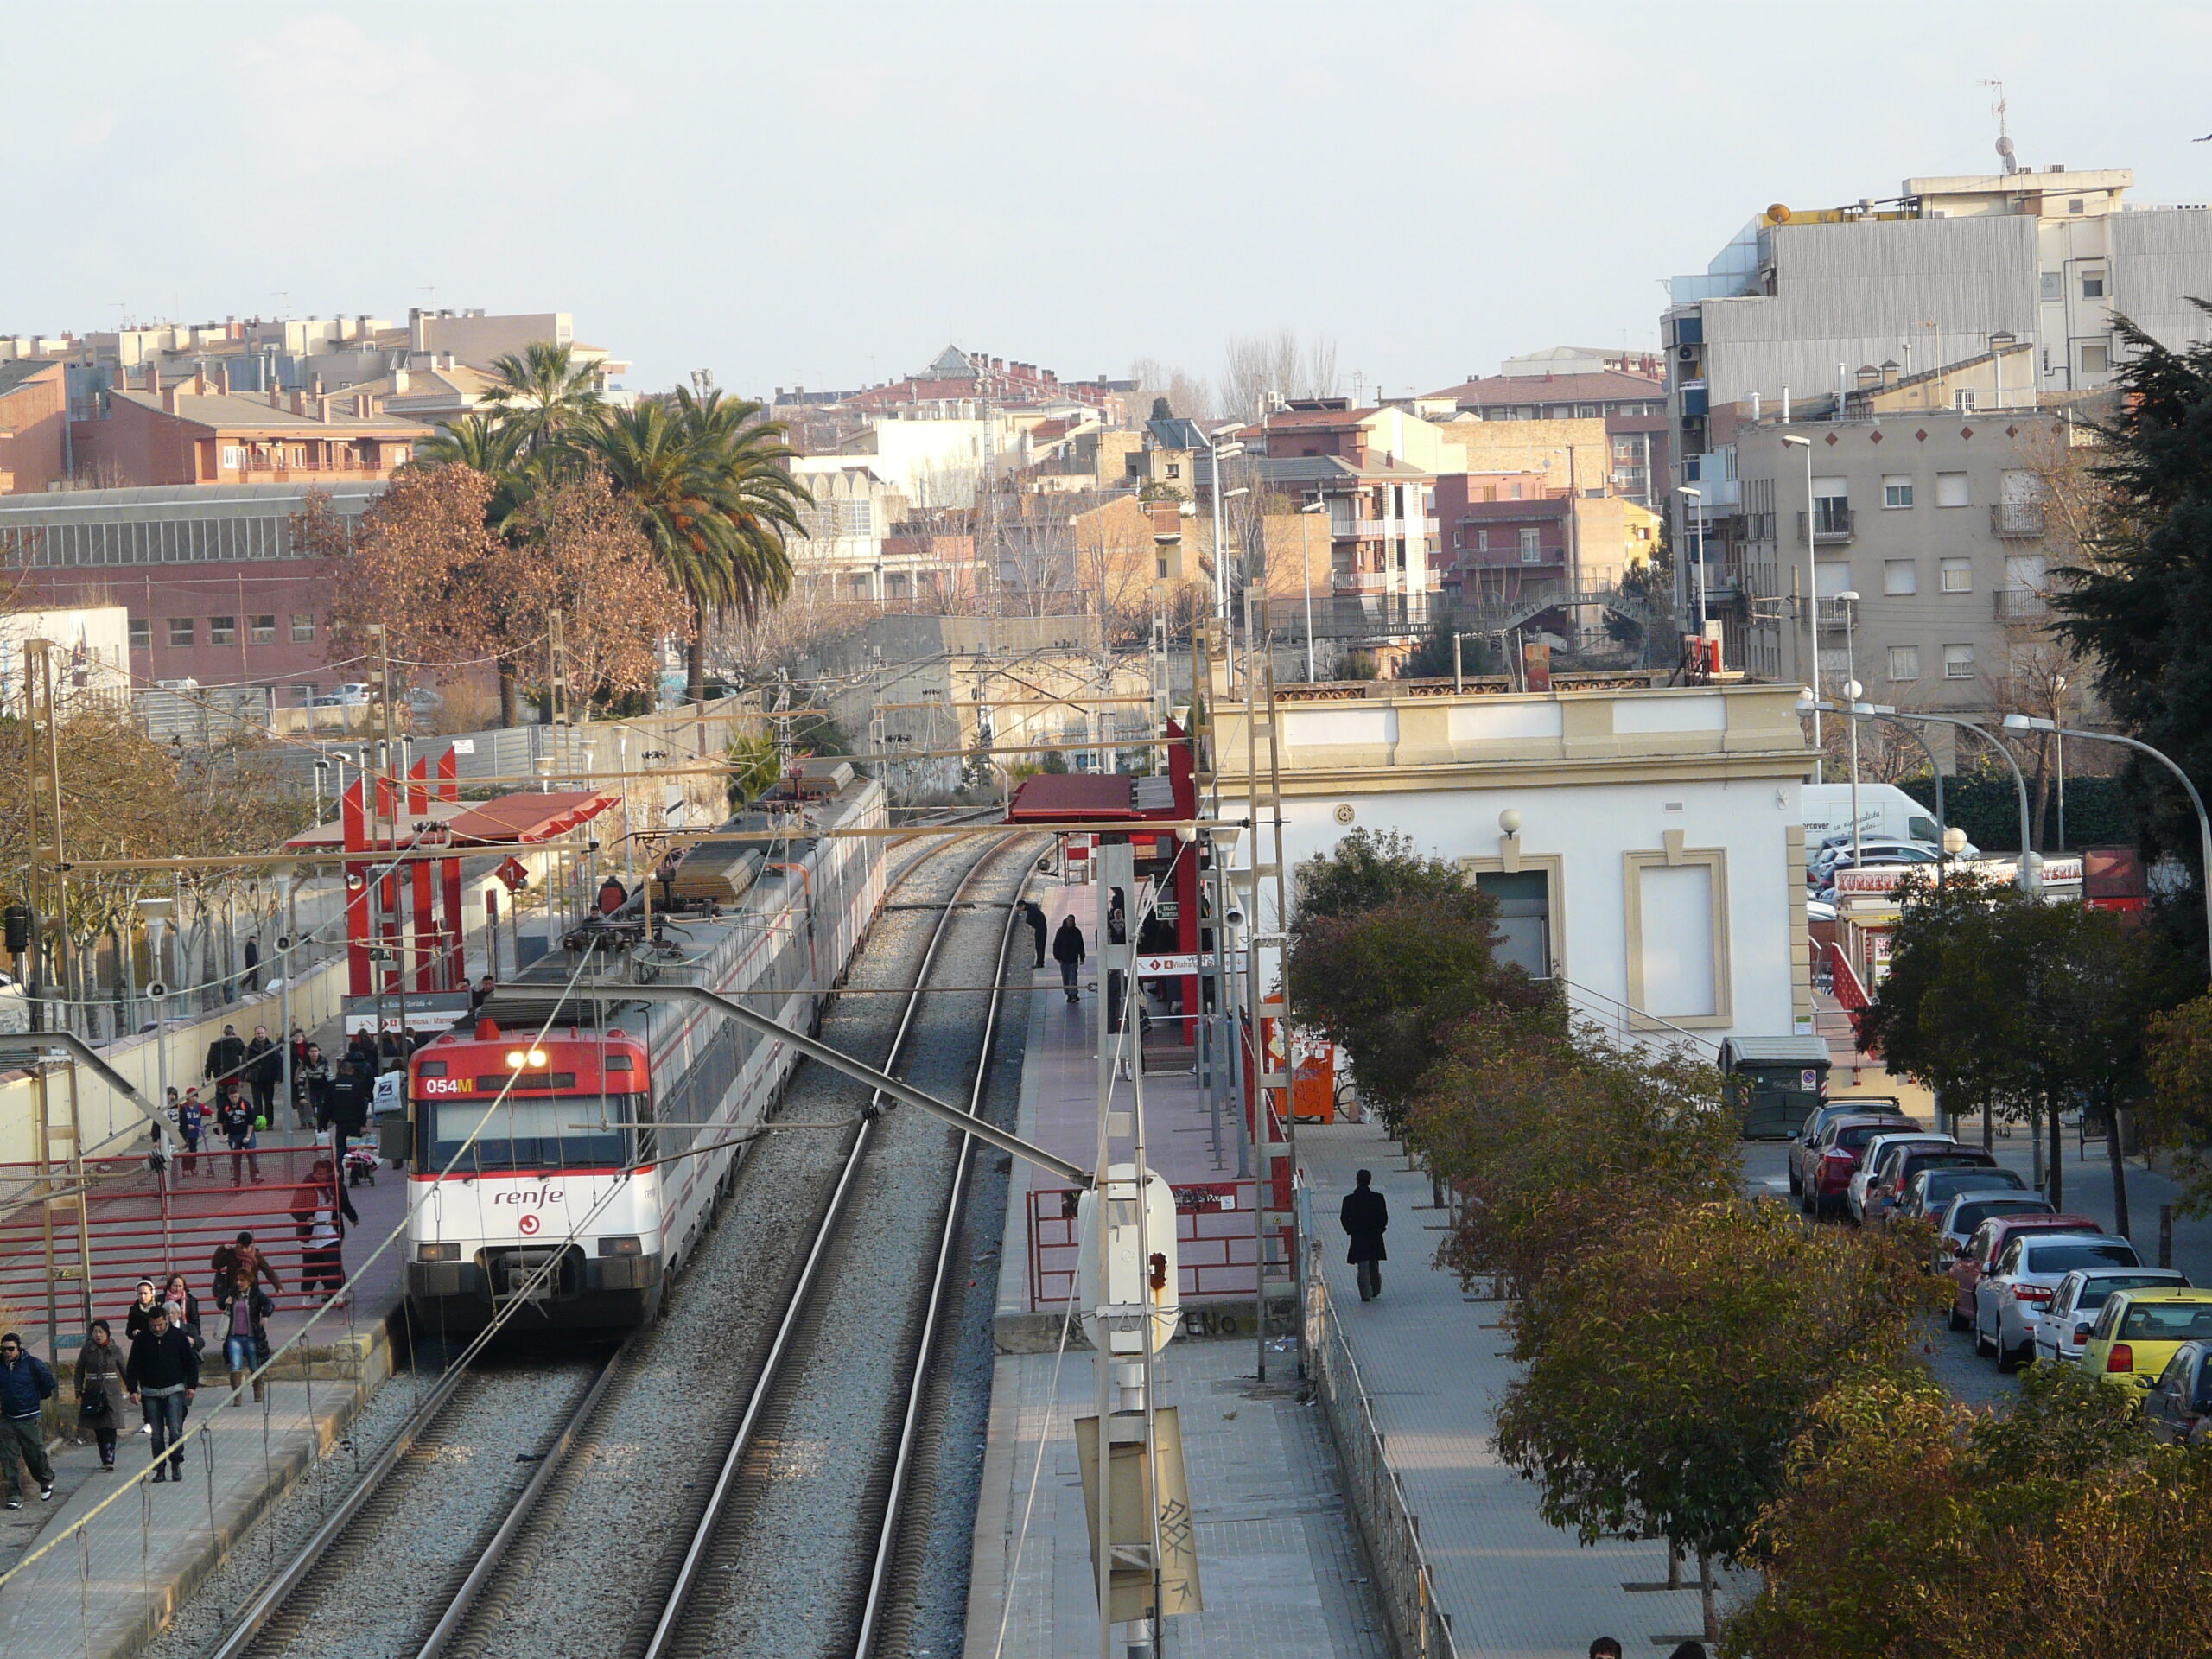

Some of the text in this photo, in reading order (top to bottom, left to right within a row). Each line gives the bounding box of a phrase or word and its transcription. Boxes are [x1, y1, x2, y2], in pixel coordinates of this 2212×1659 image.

[1844, 810, 1880, 828] espialista
[506, 866, 515, 881] 1
[426, 1078, 474, 1094] 054M
[493, 1183, 563, 1211] renfe
